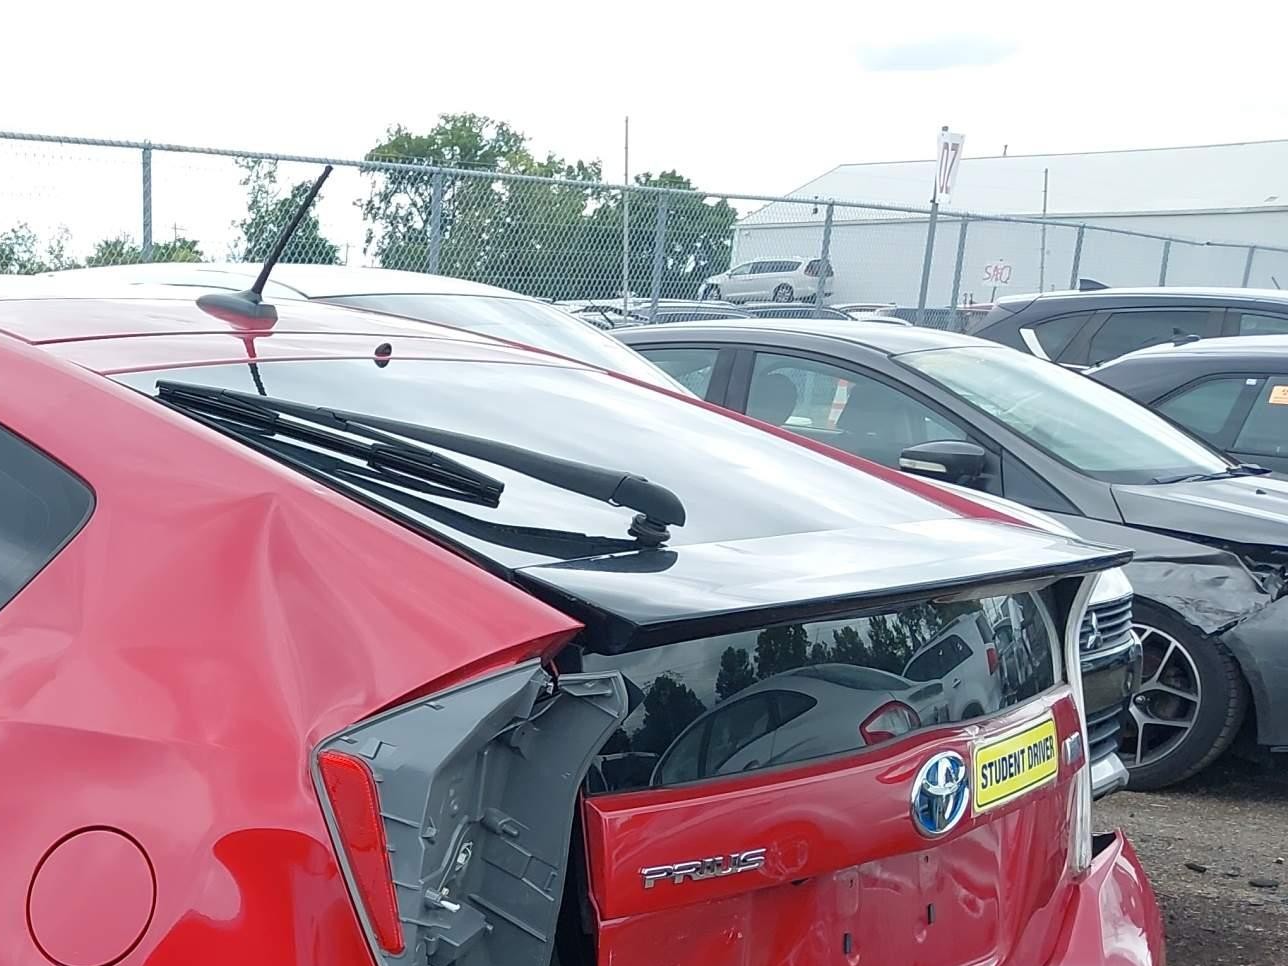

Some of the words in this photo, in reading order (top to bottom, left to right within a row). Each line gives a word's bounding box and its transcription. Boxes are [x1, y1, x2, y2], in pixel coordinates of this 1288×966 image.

[981, 748, 1025, 789] STUDENT
[1027, 735, 1055, 770] DRIVER
[639, 848, 767, 889] PRIUS
